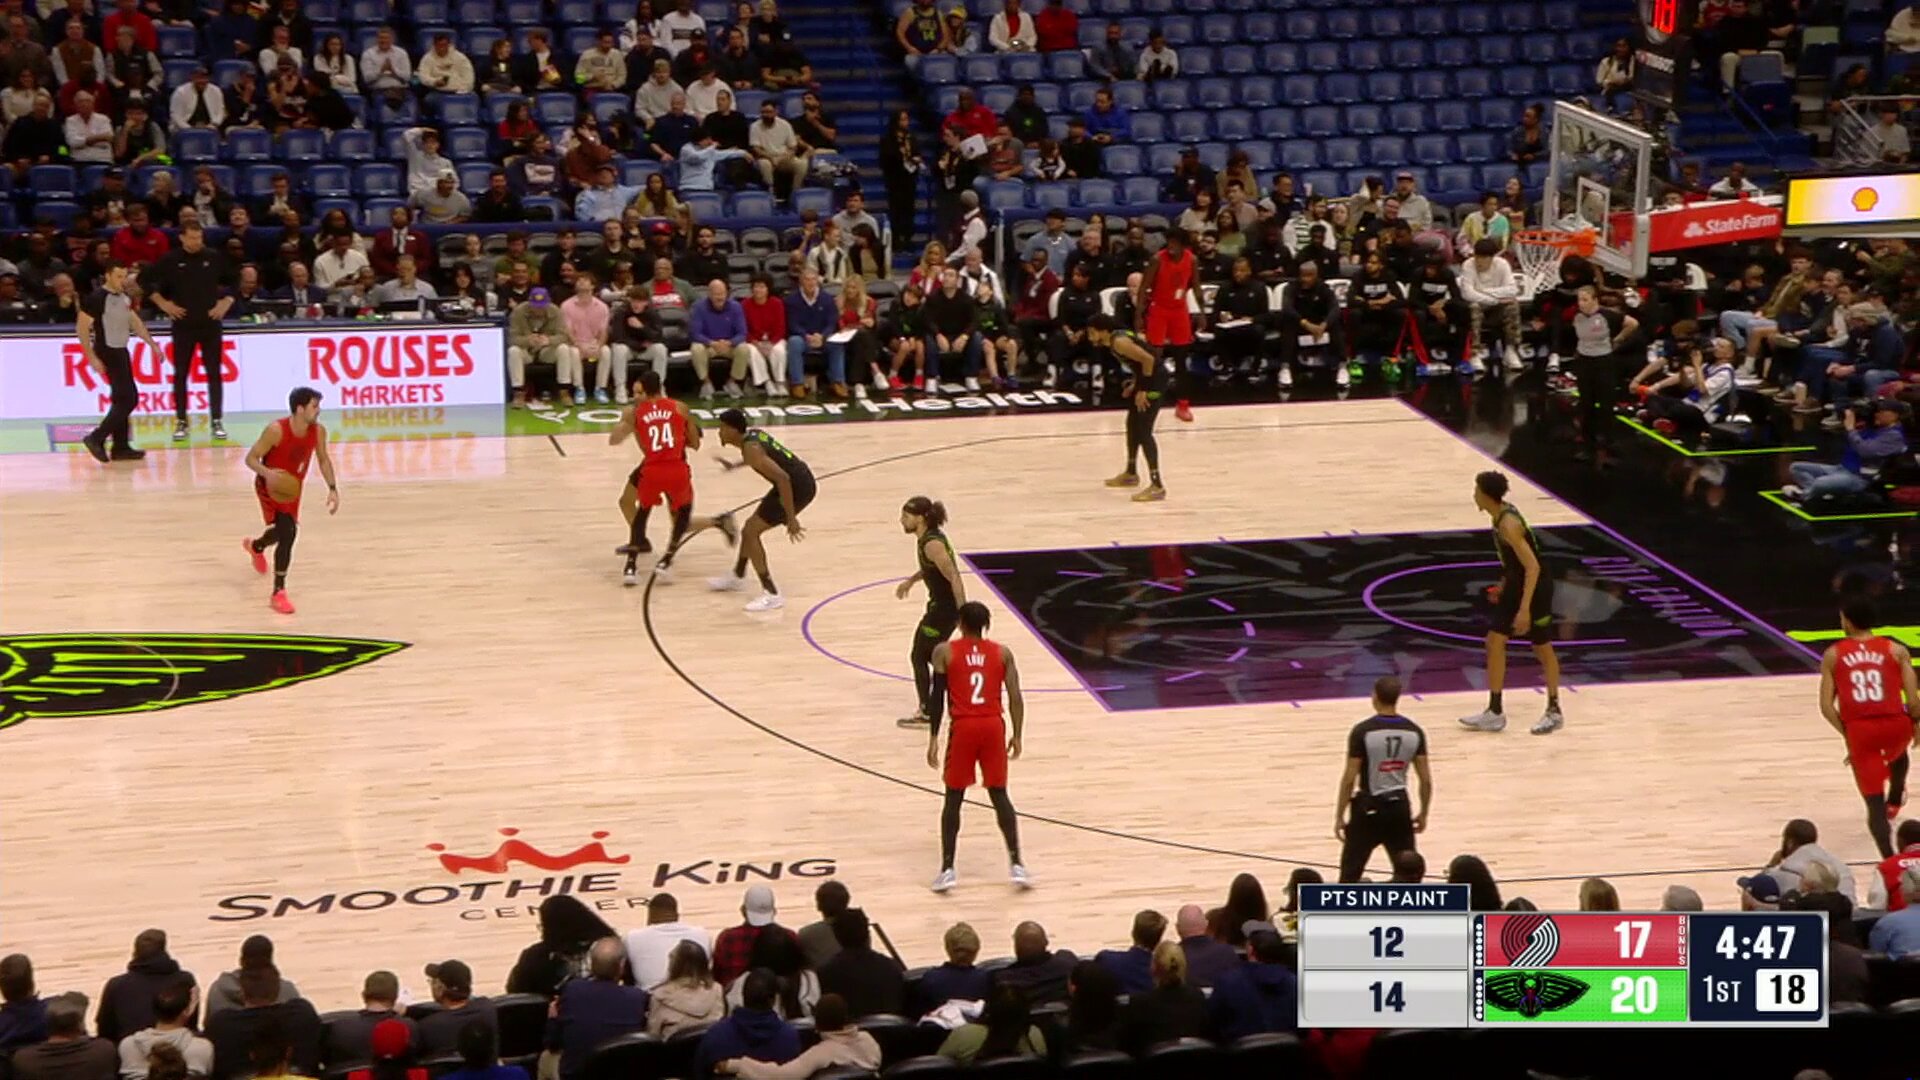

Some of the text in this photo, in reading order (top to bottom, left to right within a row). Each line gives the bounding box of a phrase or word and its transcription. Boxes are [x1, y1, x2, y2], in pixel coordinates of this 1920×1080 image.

[307, 334, 474, 384] ROUSES
[341, 383, 445, 406] MARKETS
[861, 390, 1083, 412] Health
[648, 422, 674, 452] 24
[969, 671, 985, 704] 2
[1850, 669, 1884, 702] 33
[1385, 736, 1402, 757] 17
[208, 872, 623, 921] SMOOTHIE
